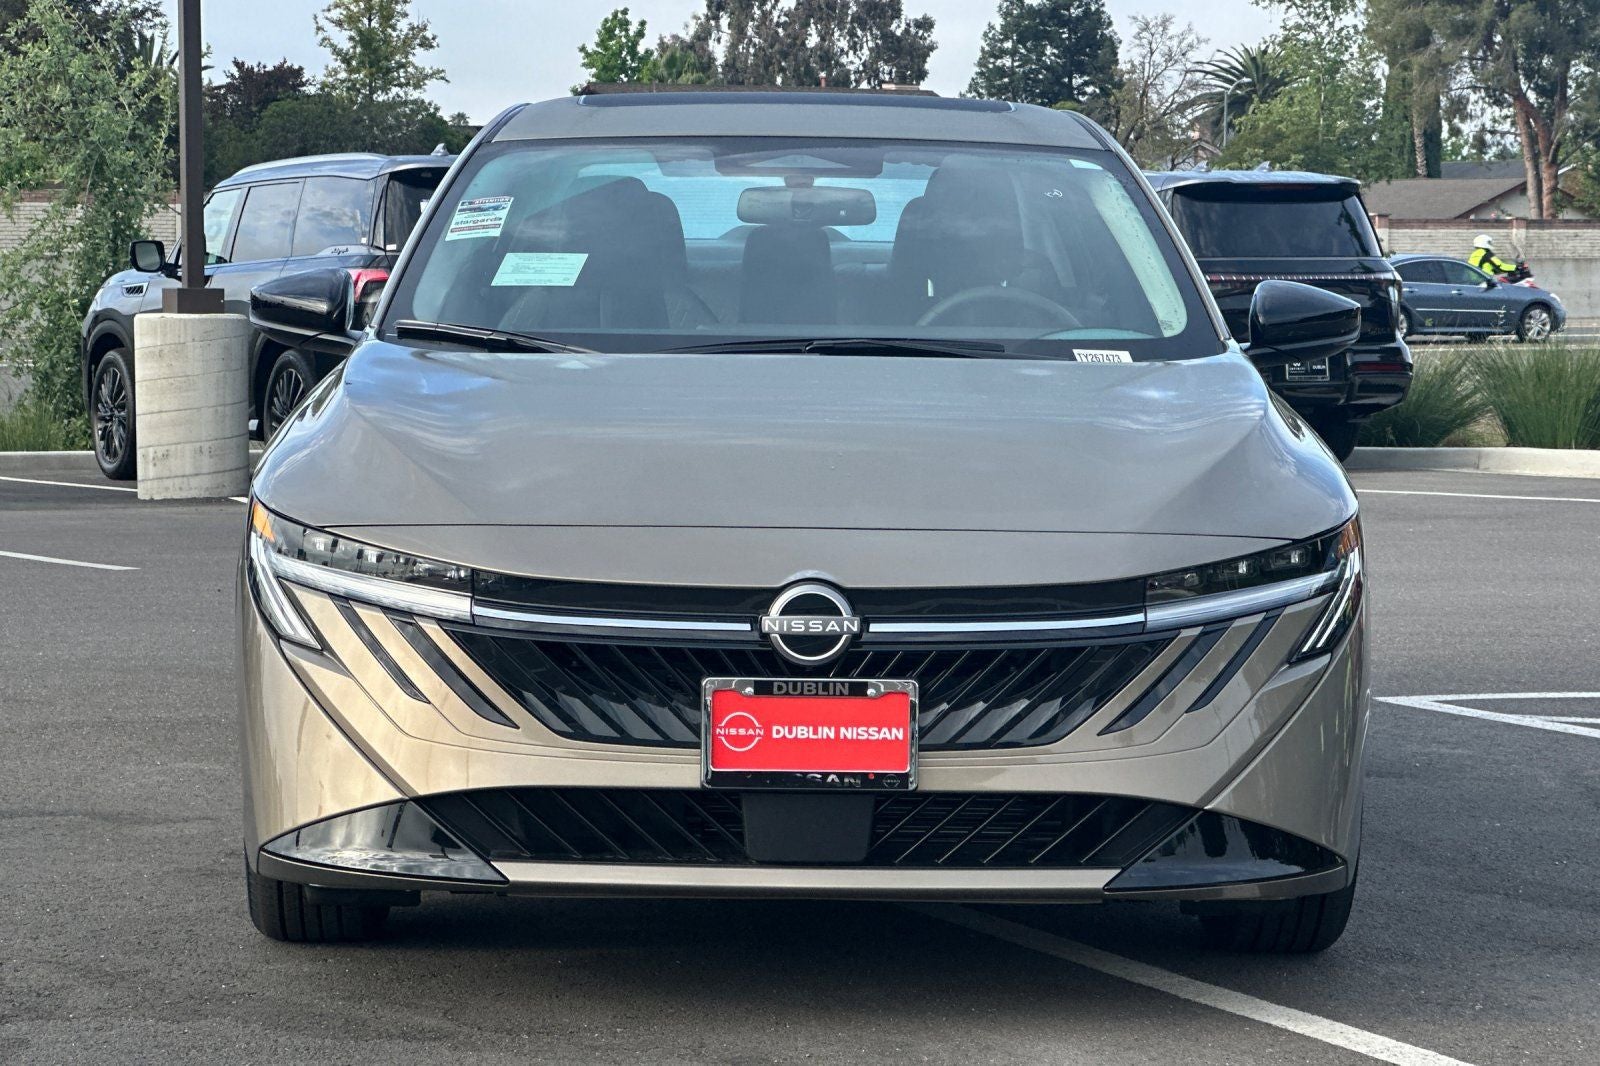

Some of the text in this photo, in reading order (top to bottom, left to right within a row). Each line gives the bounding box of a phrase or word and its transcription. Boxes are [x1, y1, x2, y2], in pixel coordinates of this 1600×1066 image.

[764, 620, 858, 632] NISSAN
[773, 681, 849, 696] DUBLIN
[715, 728, 764, 736] NISSAN
[772, 725, 904, 741] DUBLIN NISSAN
